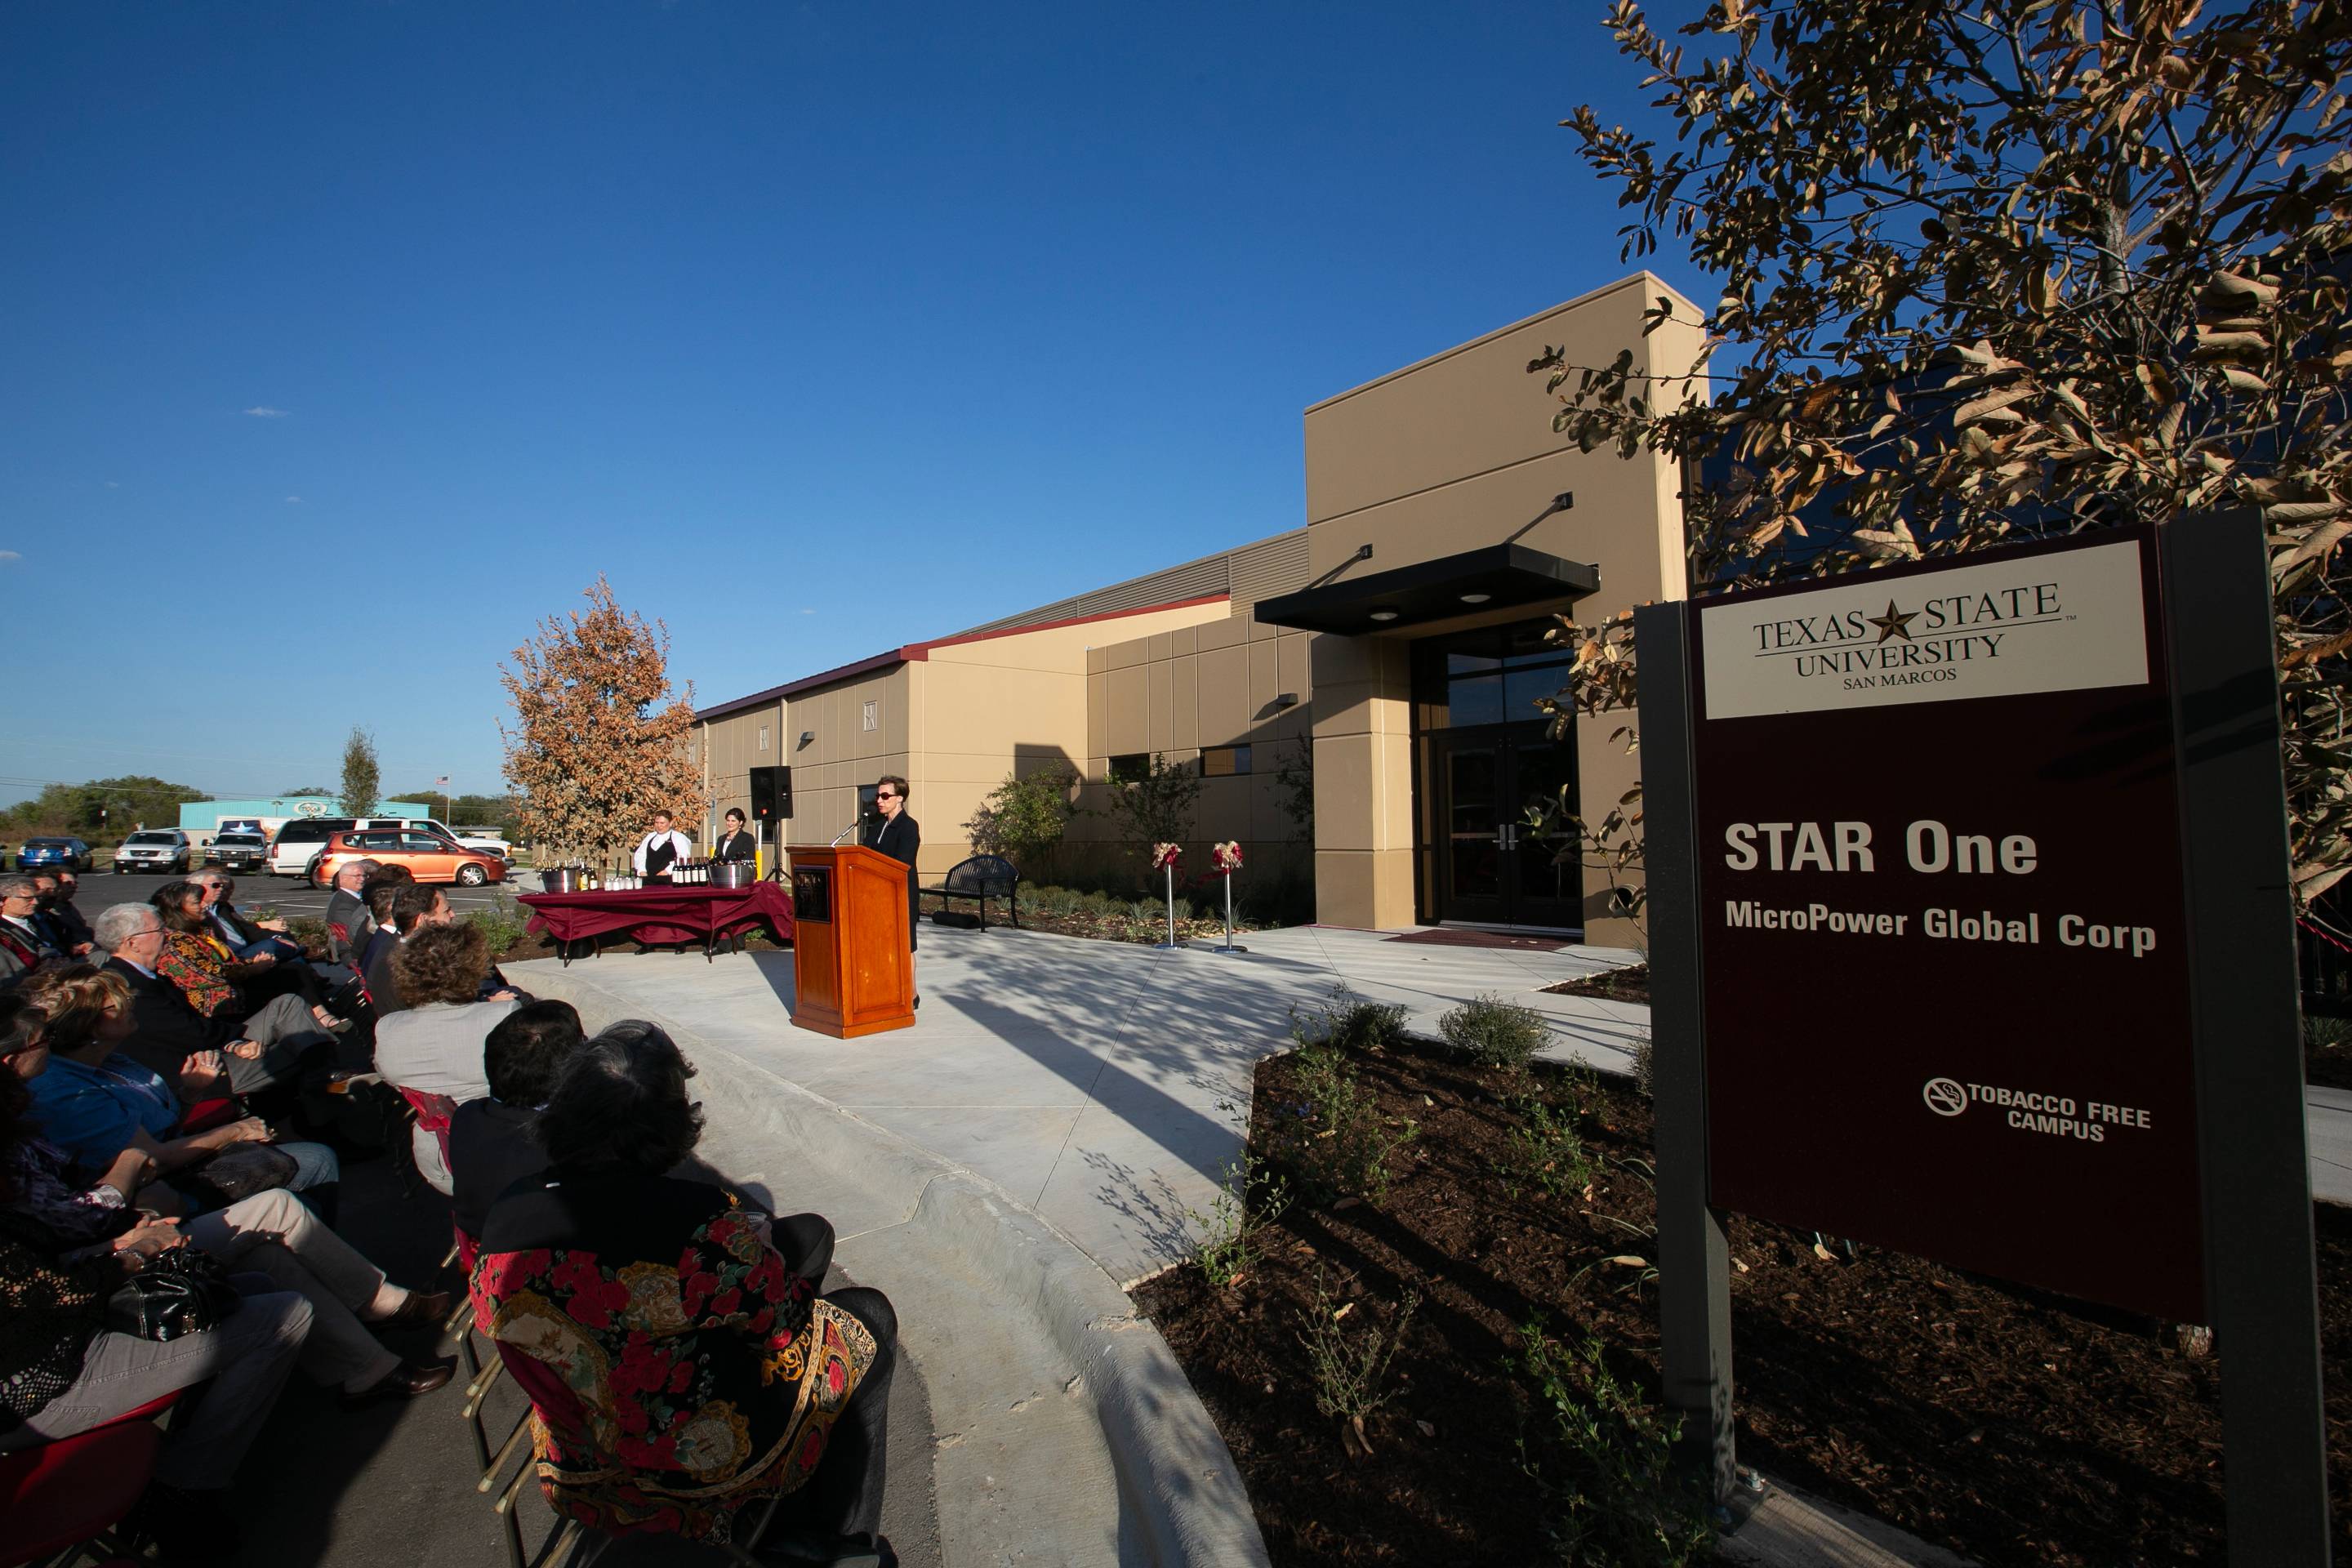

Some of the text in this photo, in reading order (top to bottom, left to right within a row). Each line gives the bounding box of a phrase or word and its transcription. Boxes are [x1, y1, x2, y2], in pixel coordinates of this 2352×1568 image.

[1753, 610, 1866, 650] TEXAS
[1925, 582, 2063, 630] STATE
[1794, 633, 2006, 678] UNIVERSITY
[1842, 668, 1958, 691] SAN MARCOS
[1725, 819, 2038, 875] STAR One
[1725, 900, 2157, 958] MicroPower Global Corp
[1967, 1083, 2151, 1129] TOBACCO FREE
[2007, 1110, 2105, 1143] CAMPUS
